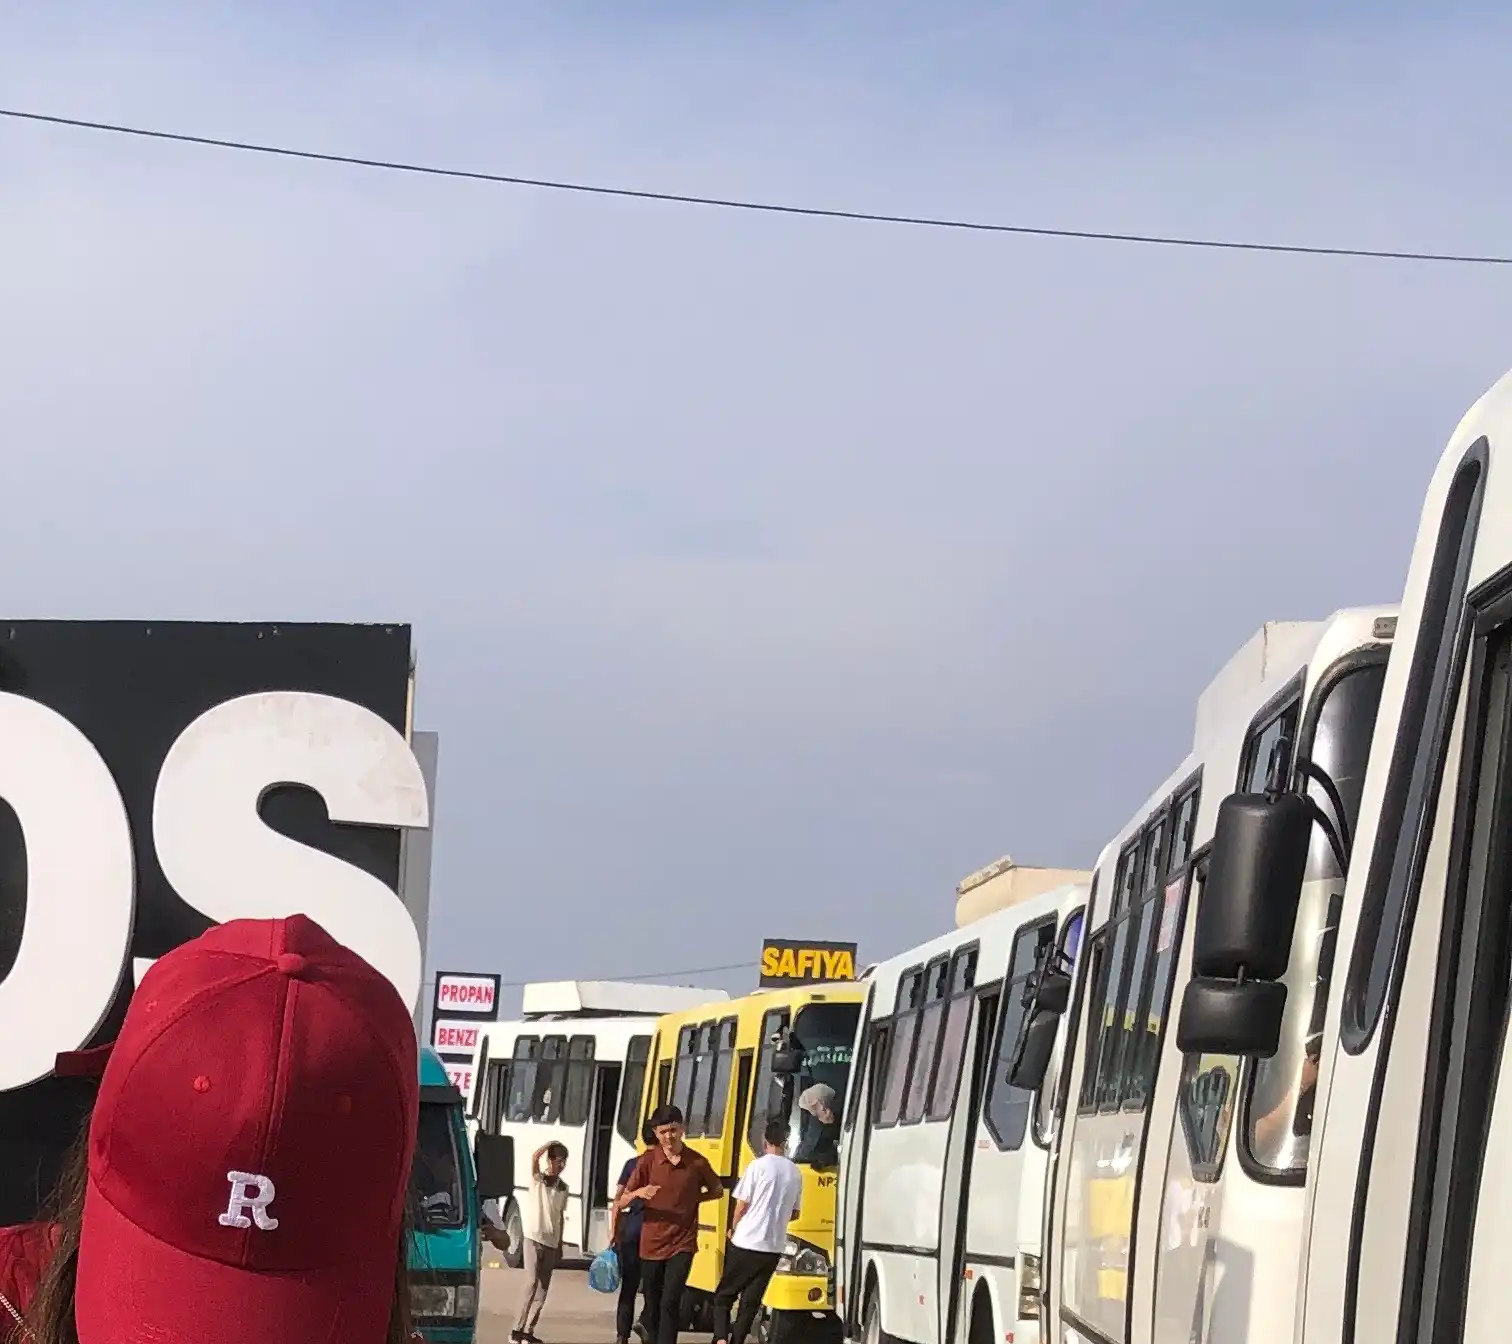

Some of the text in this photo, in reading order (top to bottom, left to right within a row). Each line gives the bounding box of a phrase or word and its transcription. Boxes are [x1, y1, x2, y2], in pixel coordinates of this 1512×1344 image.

[760, 947, 855, 979] SAFIYA
[441, 984, 494, 1004] PROPAN
[438, 1028, 479, 1047] BENZI
[218, 1170, 279, 1231] R
